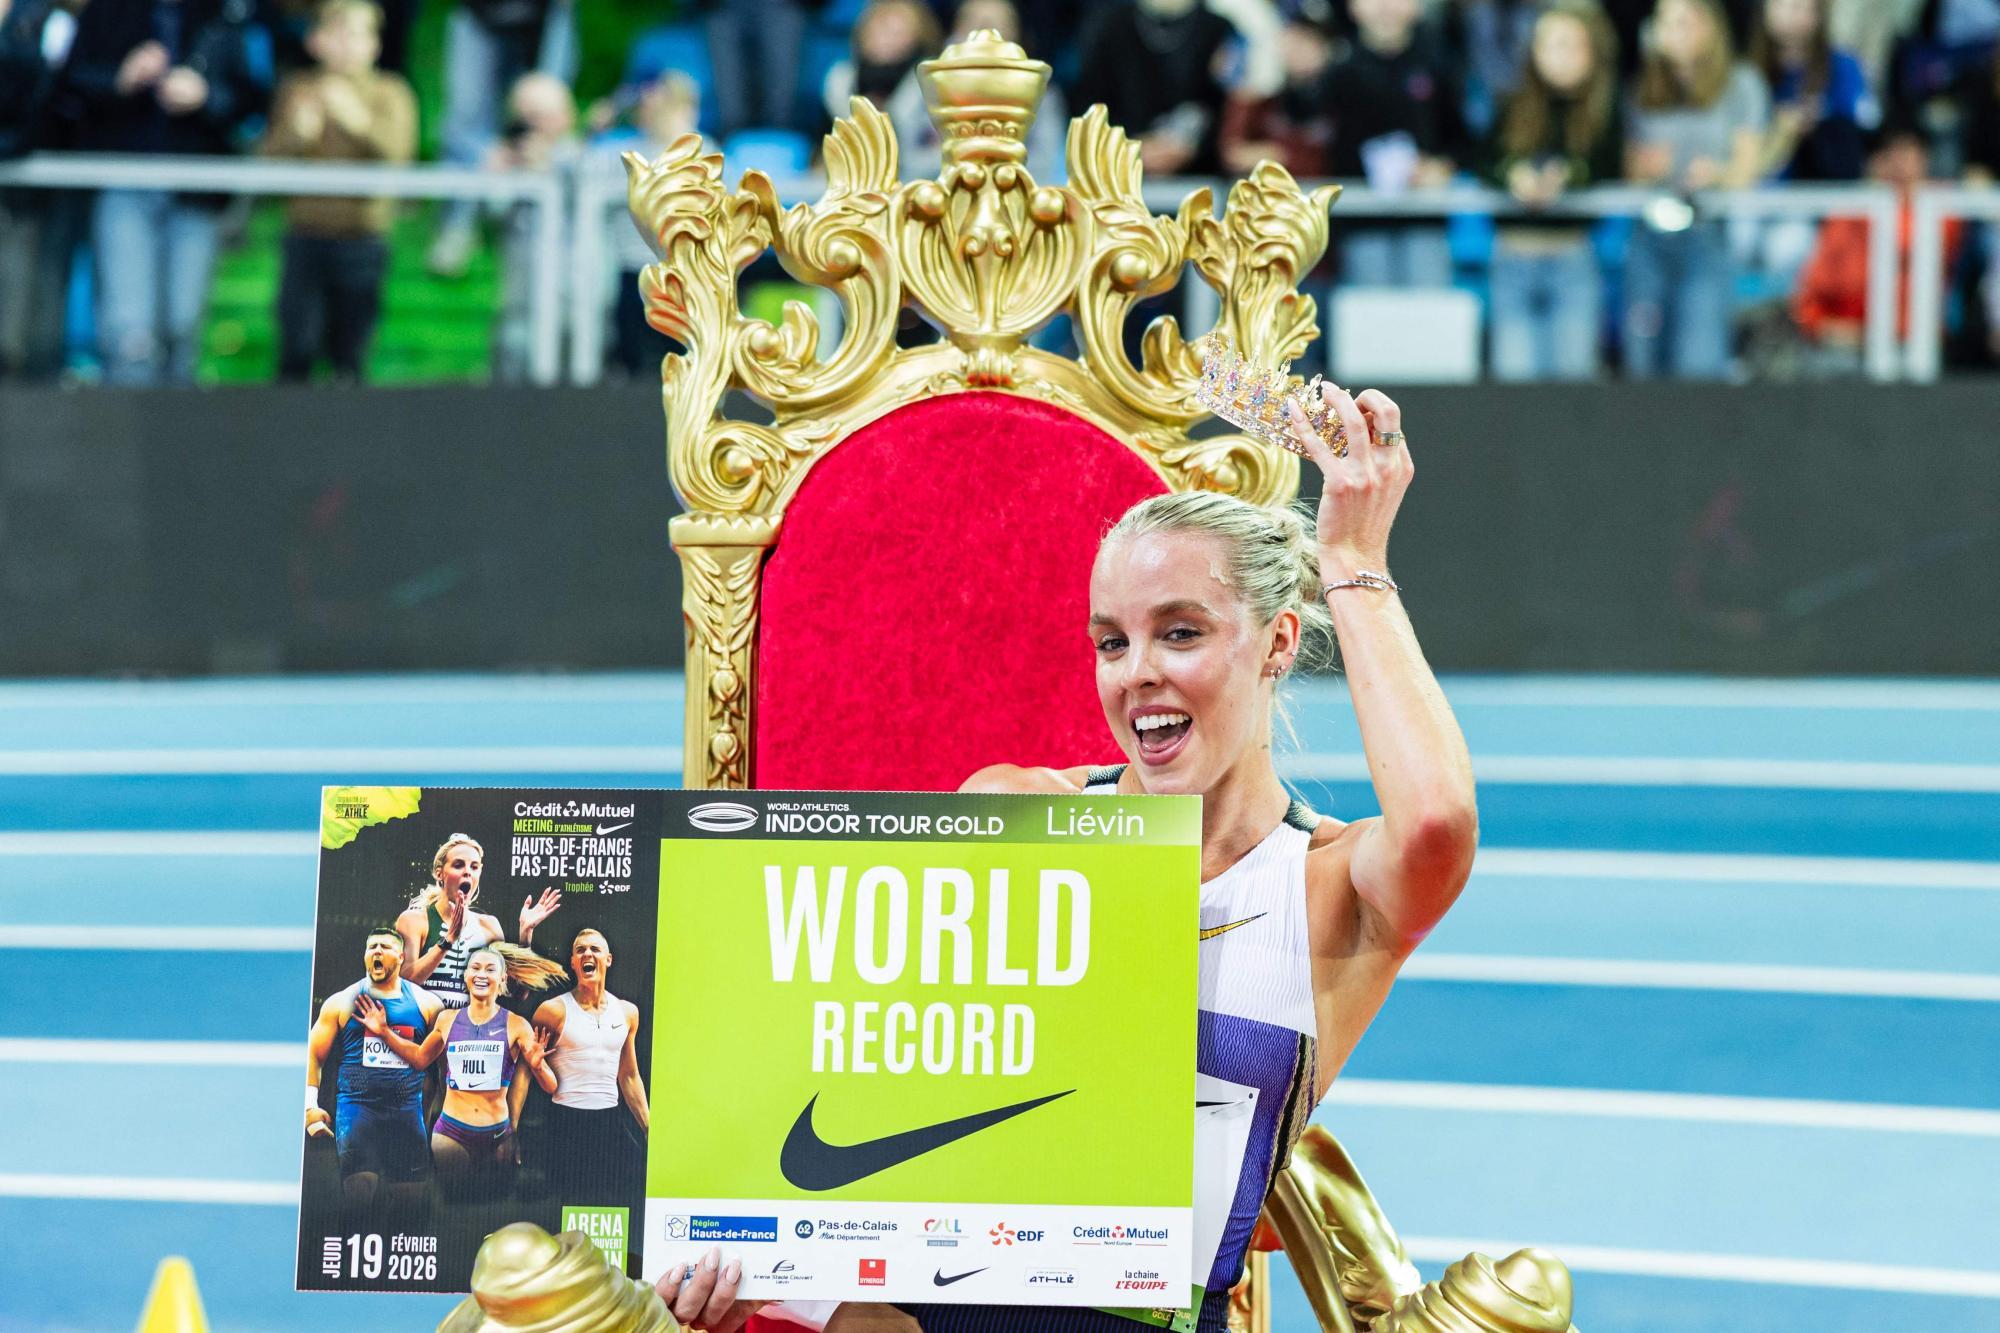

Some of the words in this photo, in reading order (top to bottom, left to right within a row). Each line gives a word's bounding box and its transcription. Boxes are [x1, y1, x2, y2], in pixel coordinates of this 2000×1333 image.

[514, 802, 562, 817] Crédit
[581, 803, 635, 818] Mutuel
[767, 803, 800, 811] WORLD
[801, 803, 850, 812] ATHLETICS
[513, 818, 553, 832] MEETING
[765, 813, 860, 833] INDOOR
[865, 814, 931, 834] TOUR
[935, 815, 1004, 835] GOLD
[1047, 806, 1144, 836] Liévin
[511, 836, 633, 856] HAUTS-DE-FRANCE
[510, 855, 632, 878] PAS-DE-CALAIS
[565, 881, 594, 893] Trophée
[764, 865, 1092, 986] WORLD
[365, 1042, 392, 1054] KOV
[811, 1000, 1036, 1076] RECORD
[462, 1059, 486, 1074] HULL
[567, 1213, 623, 1237] ARENA
[692, 1219, 719, 1228] Région
[797, 1223, 811, 1235] 62
[1073, 1226, 1110, 1238] Crédit
[1126, 1227, 1168, 1239] Mutuel
[391, 1232, 437, 1252] FÉVRIER
[691, 1229, 775, 1239] Hauts-de-France
[322, 1237, 342, 1279] JEUDI
[347, 1233, 383, 1279] 19
[388, 1254, 437, 1280] 2026
